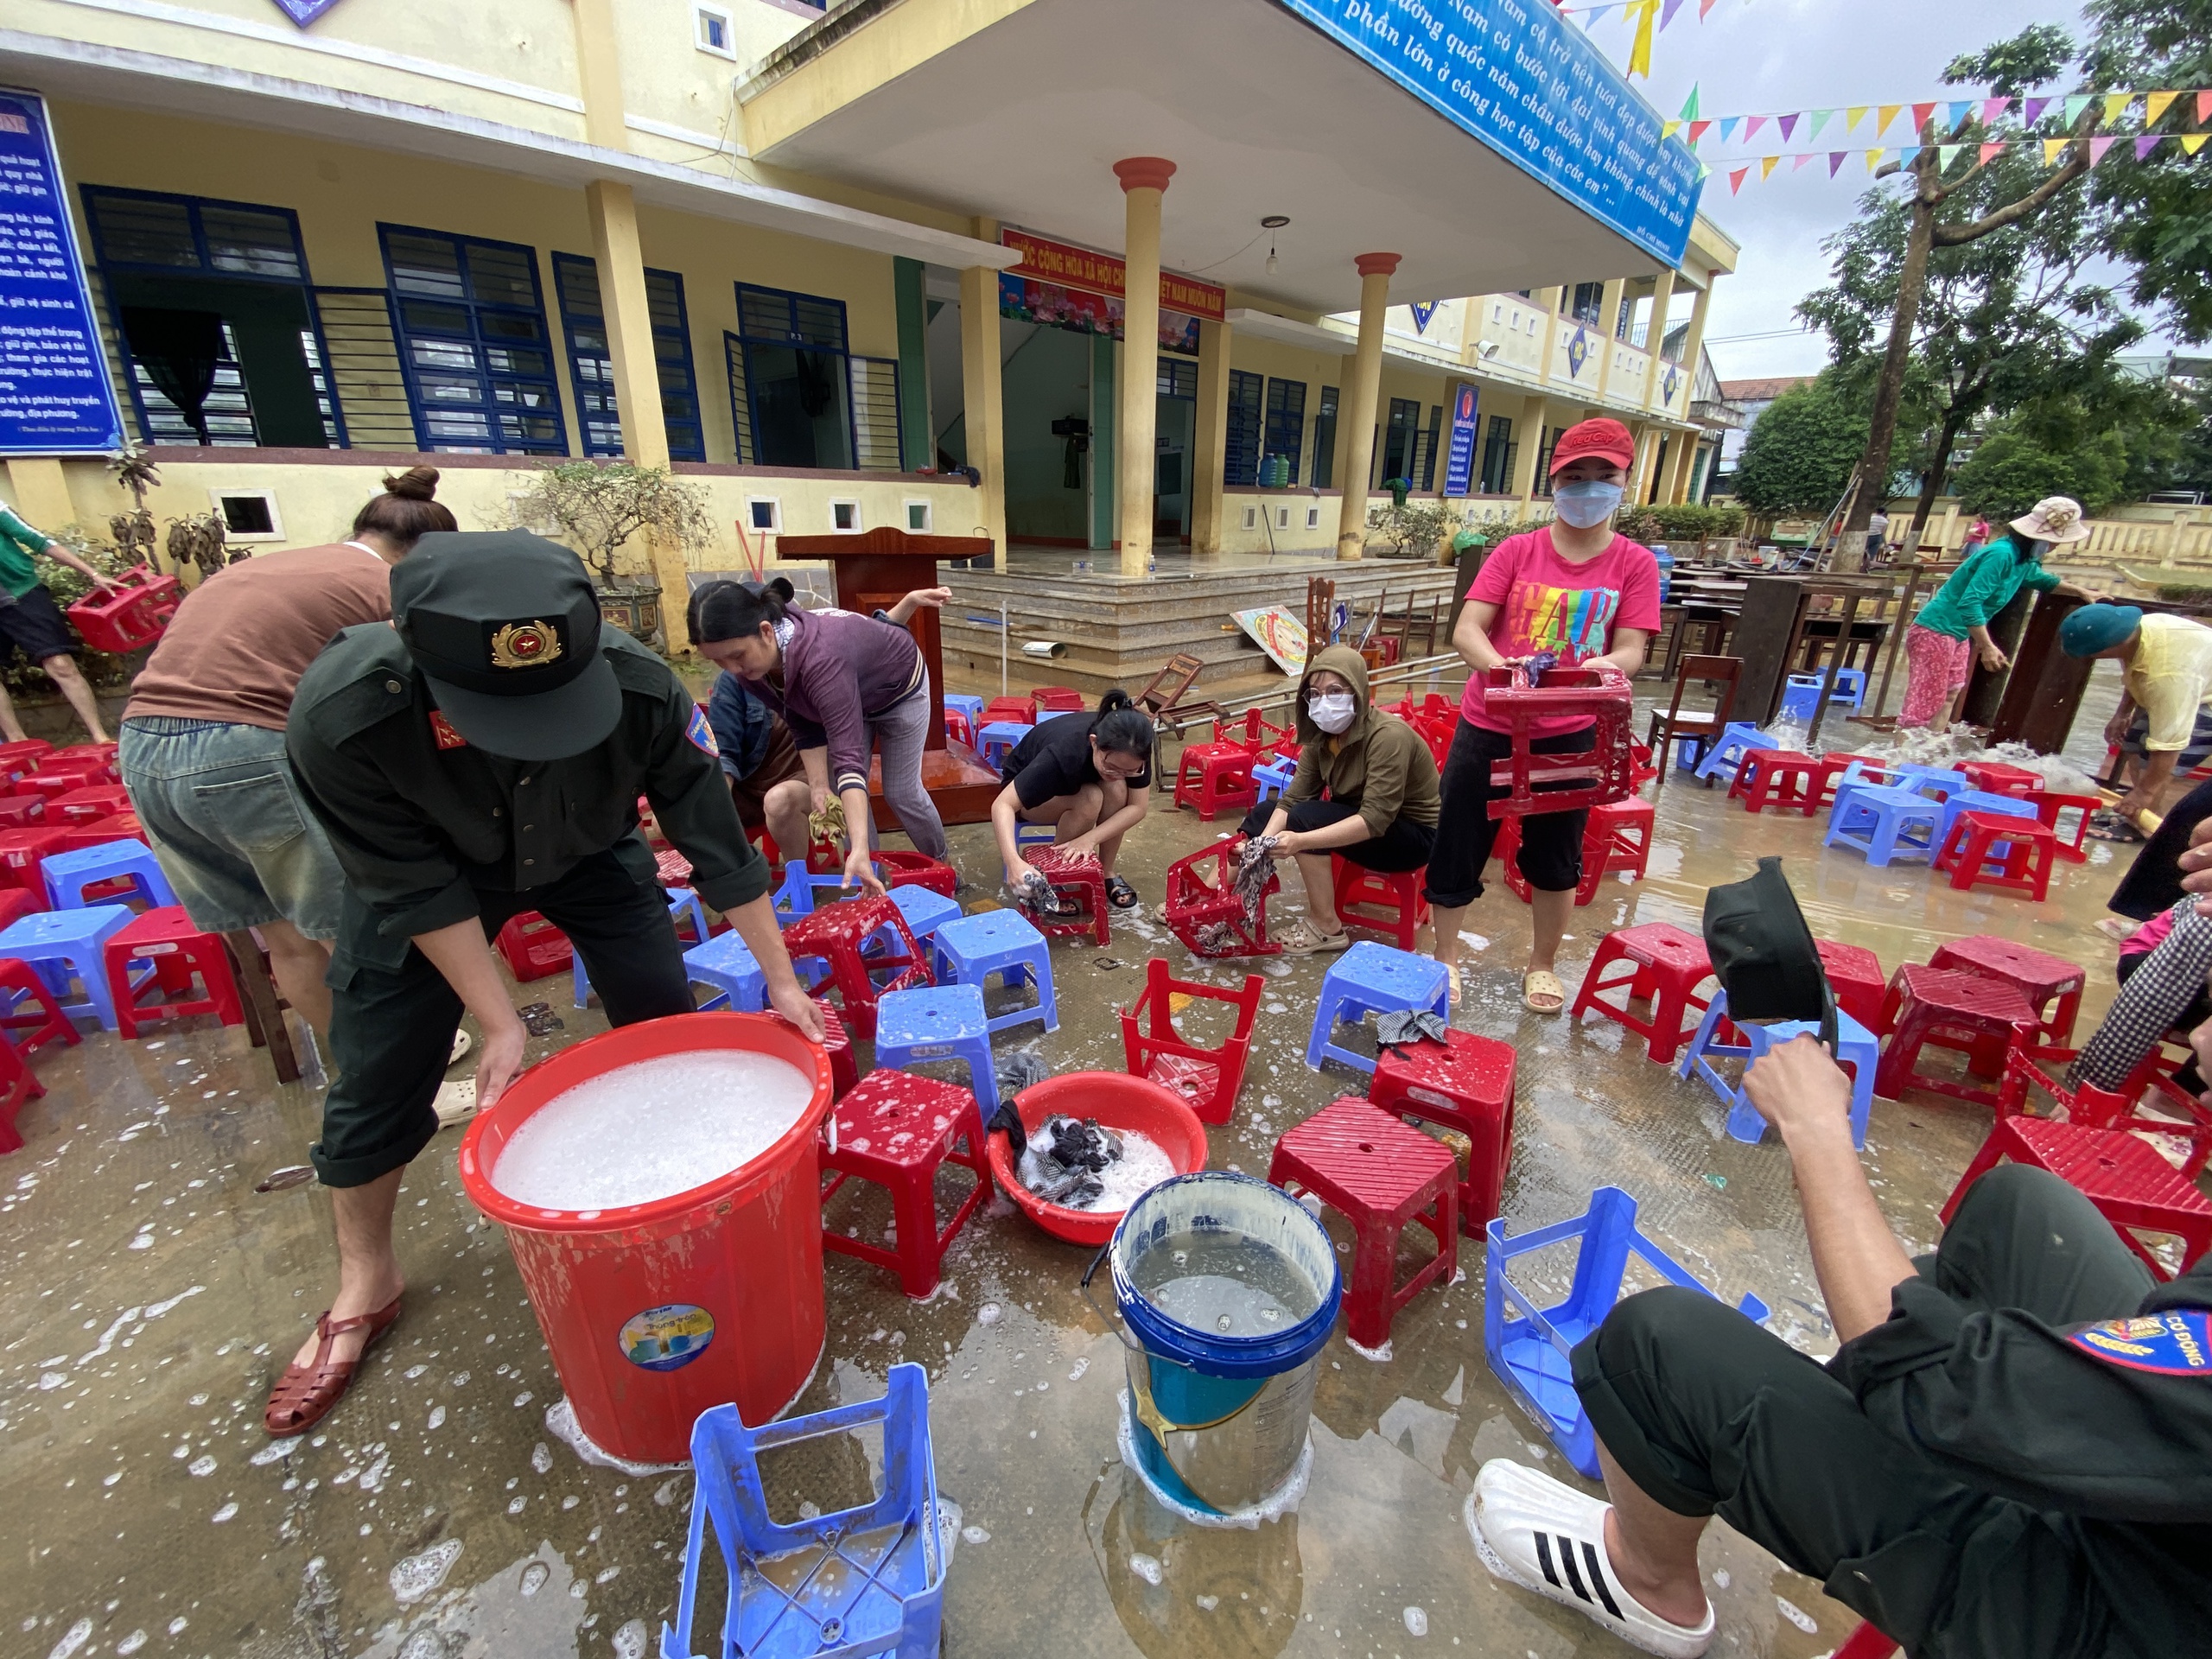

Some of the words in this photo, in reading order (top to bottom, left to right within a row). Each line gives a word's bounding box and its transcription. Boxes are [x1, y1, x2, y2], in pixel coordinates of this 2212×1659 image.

[1343, 0, 1401, 47] phần
[1403, 35, 1433, 72] lớn
[1437, 61, 1451, 82] ở
[1451, 78, 1491, 116] công
[1491, 101, 1516, 132] học
[1517, 124, 1541, 152] tập
[1541, 145, 1564, 168] của
[1564, 162, 1585, 183] các
[1389, 0, 1445, 41] ường
[1446, 33, 1486, 71] quốc
[1487, 65, 1520, 99] năm
[1521, 92, 1554, 126] châu
[1583, 132, 1604, 166] hay
[1603, 156, 1634, 193] không,
[1635, 184, 1660, 209] chính
[1659, 199, 1669, 216] là
[1668, 211, 1684, 228] nhờ
[1493, 30, 1511, 52] có
[1515, 43, 1548, 83] bước
[1551, 77, 1571, 102] tới
[1593, 117, 1616, 143] vinh
[1617, 139, 1646, 172] quang
[1530, 23, 1548, 43] có
[1548, 37, 1572, 64] trở
[1571, 60, 1594, 87] nên
[1594, 81, 1618, 110] tươi
